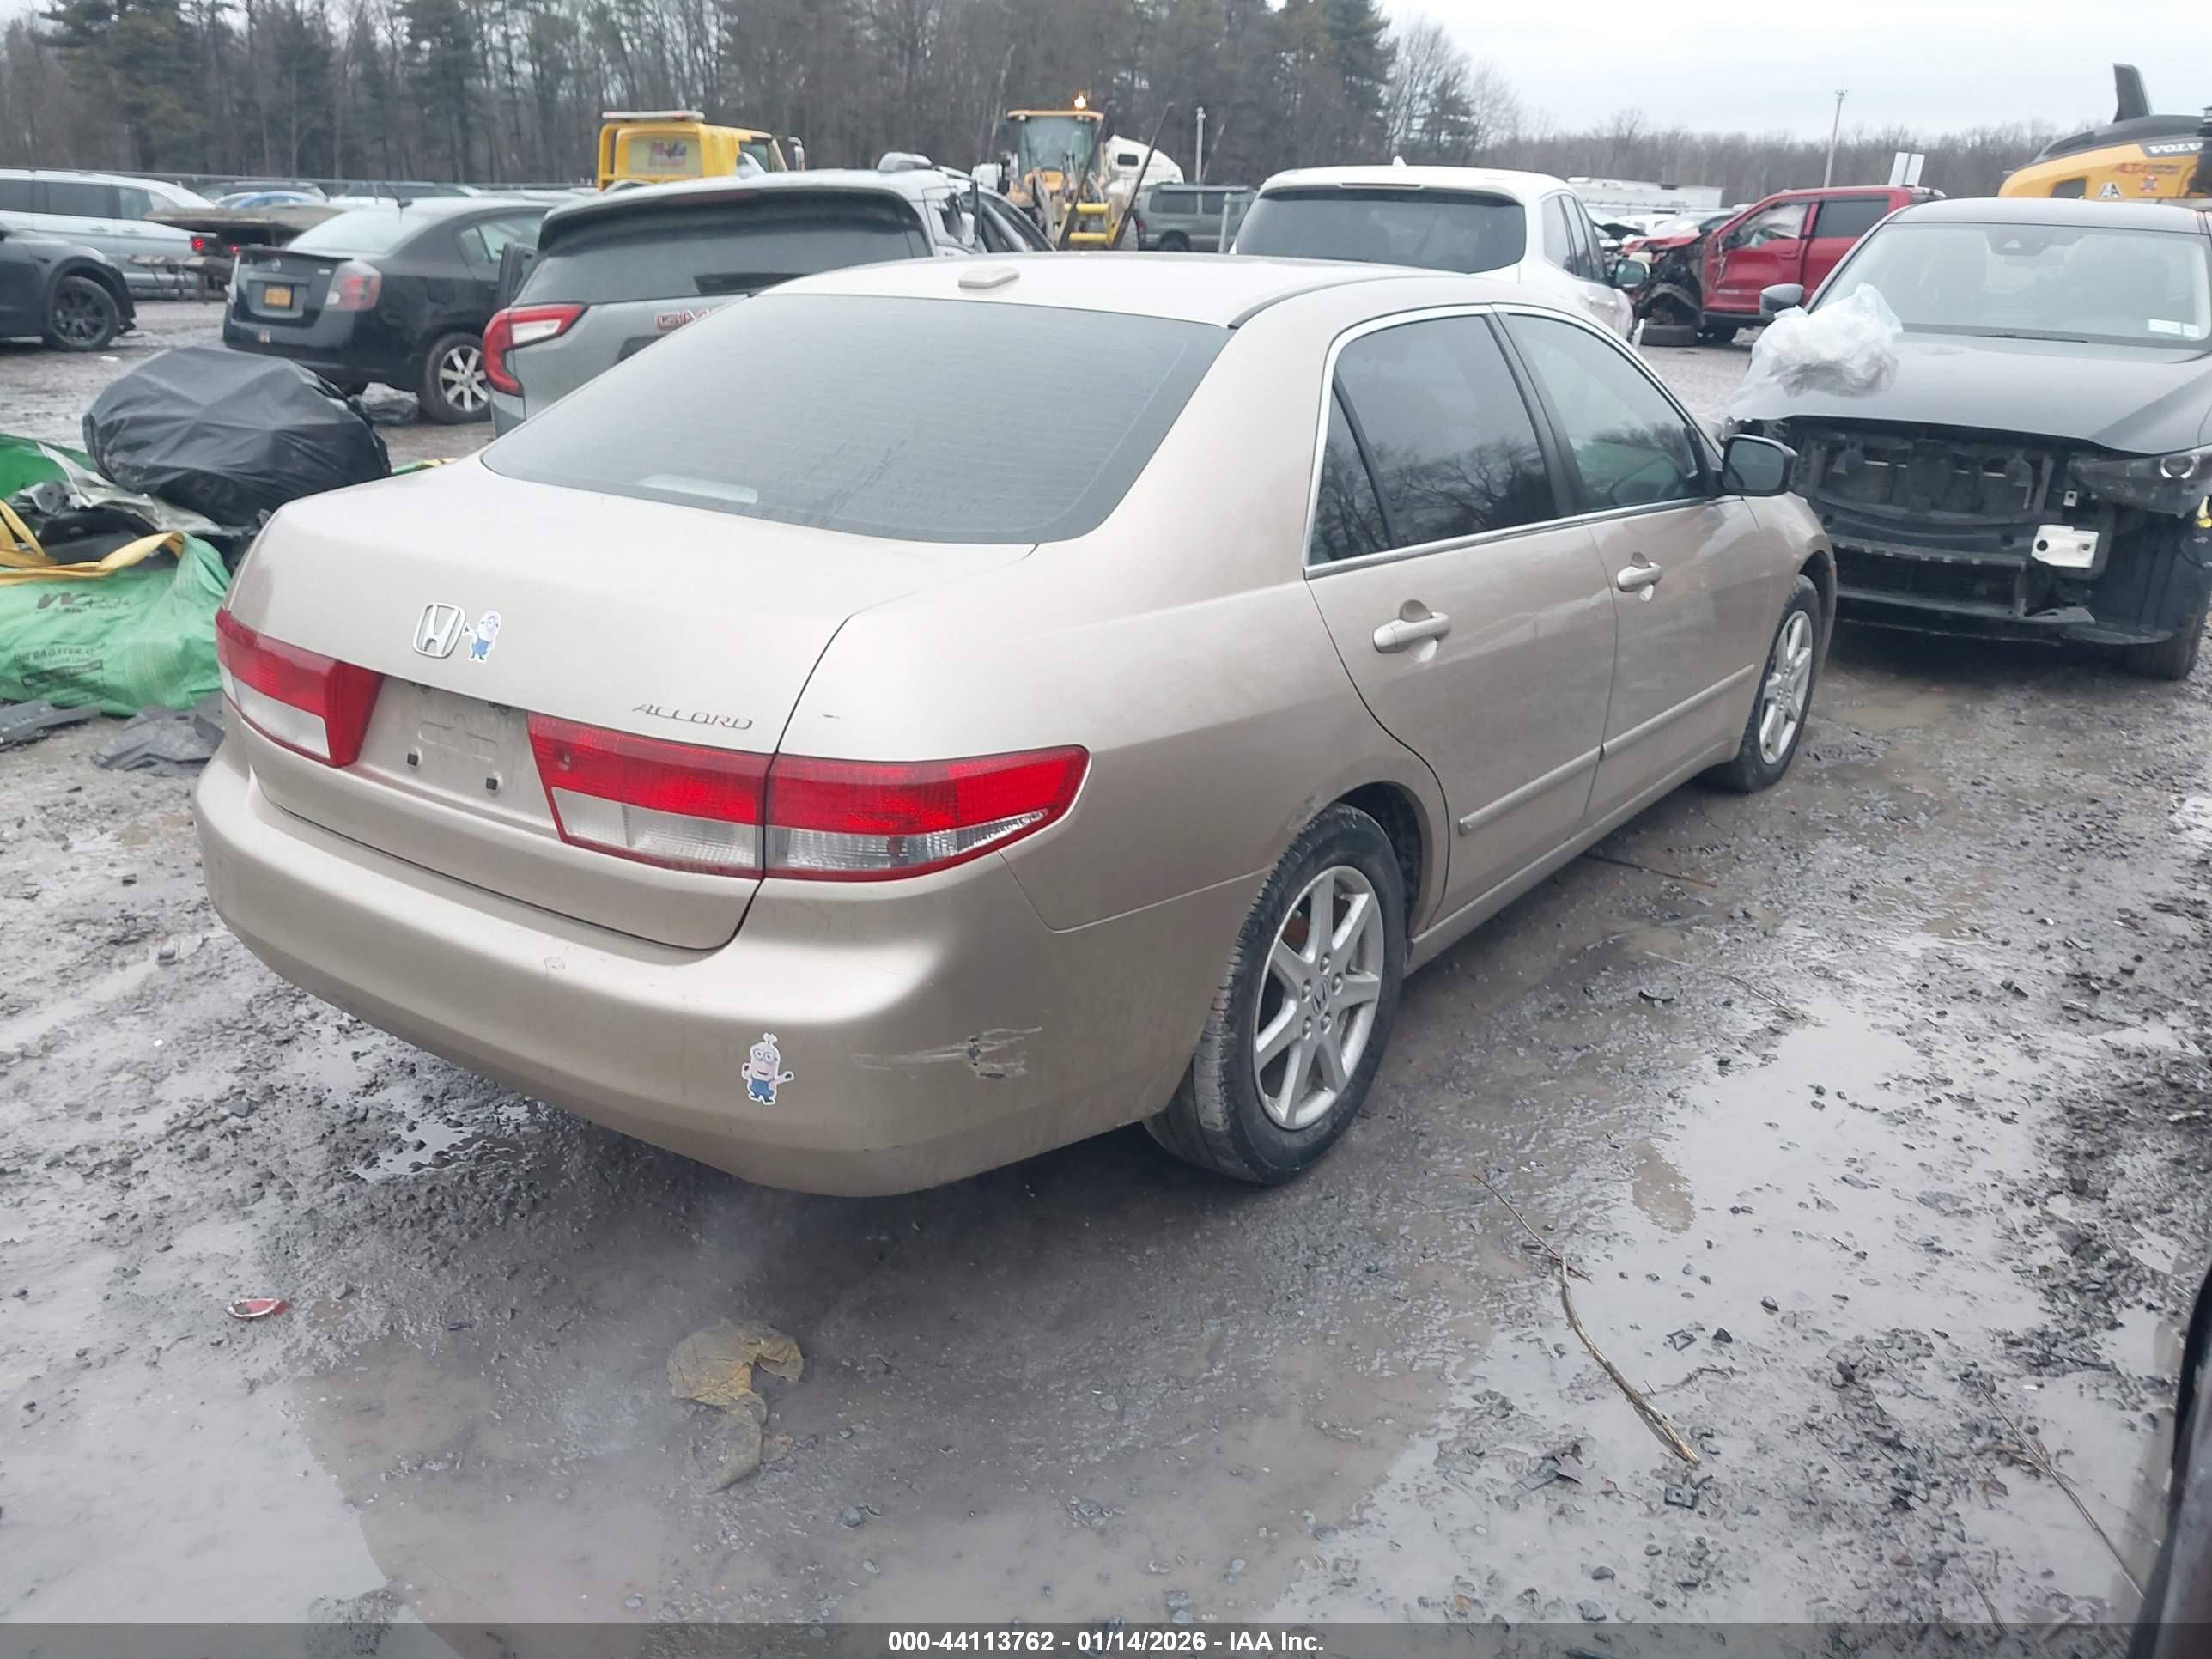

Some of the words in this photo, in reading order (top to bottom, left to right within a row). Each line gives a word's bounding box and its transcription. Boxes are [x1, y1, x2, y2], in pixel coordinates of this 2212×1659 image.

[2148, 142, 2204, 154] VOLV
[654, 308, 712, 331] GM
[631, 703, 754, 730] ACCORD
